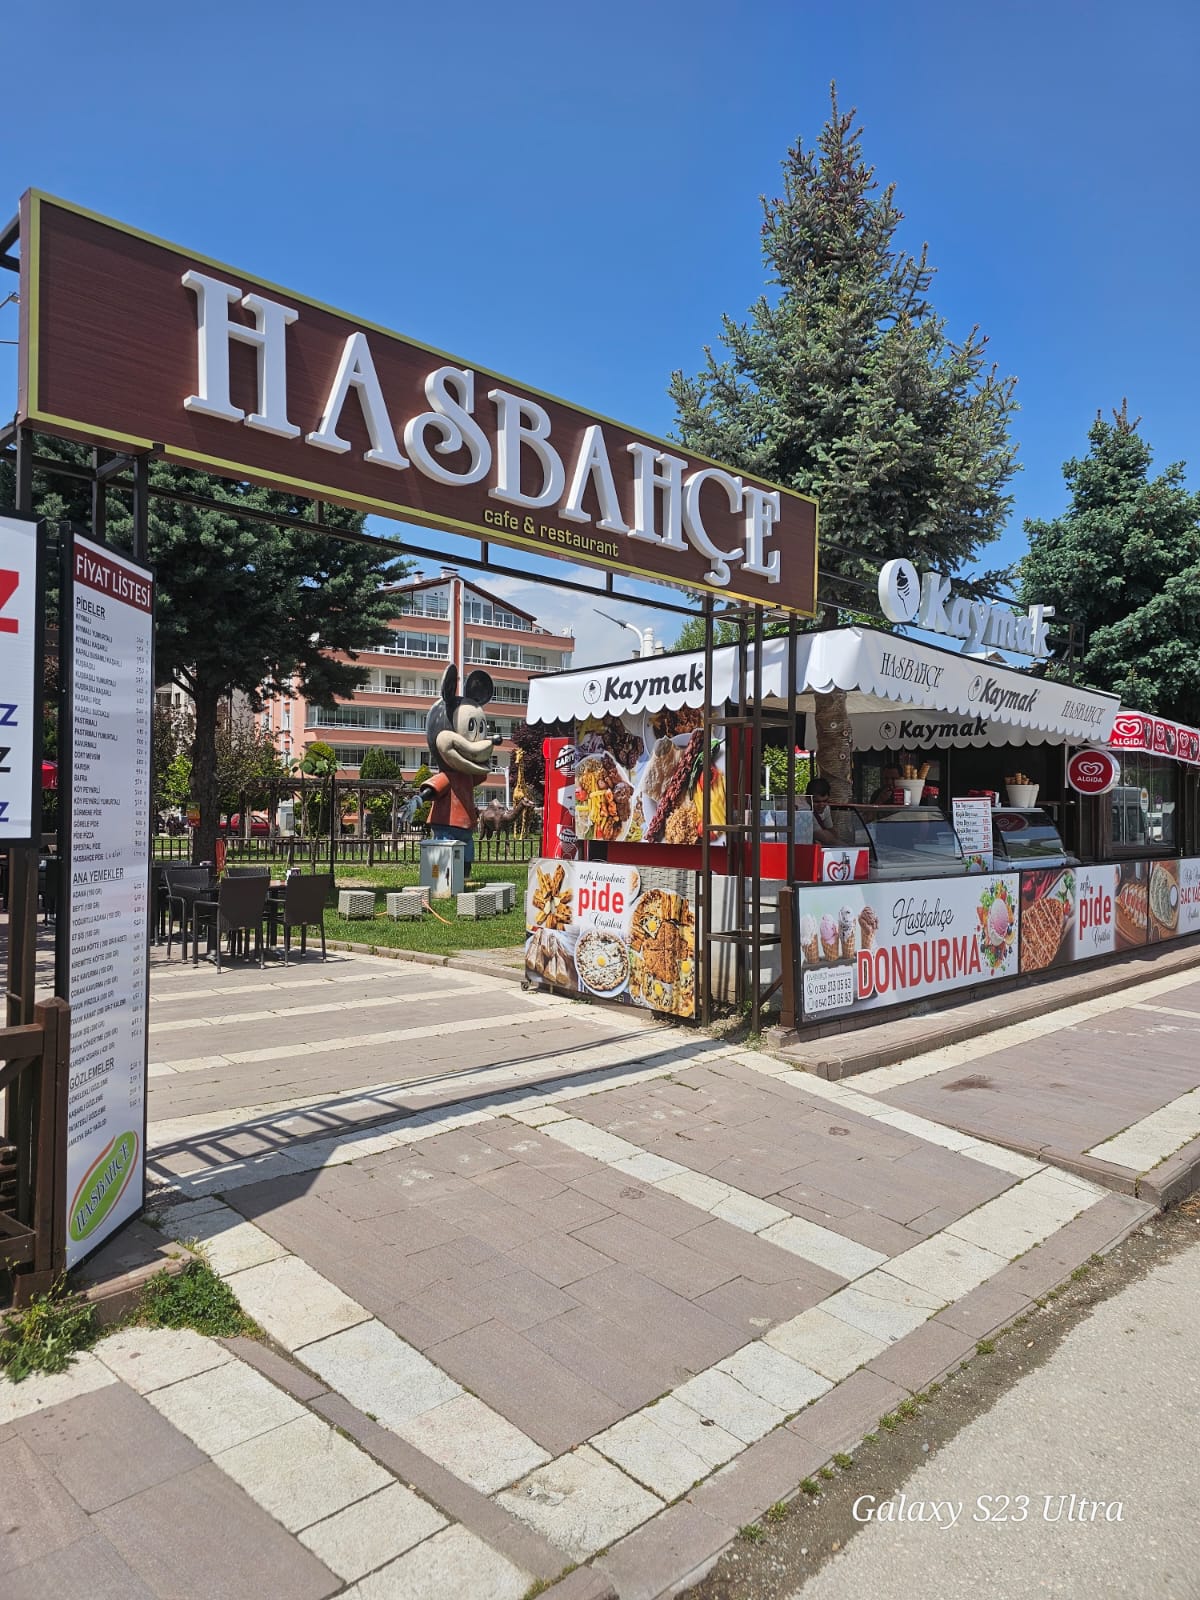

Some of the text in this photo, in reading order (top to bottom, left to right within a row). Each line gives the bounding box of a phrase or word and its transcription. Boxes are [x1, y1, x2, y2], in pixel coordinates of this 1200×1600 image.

[181, 269, 781, 586] HASBAHÇE
[484, 509, 619, 557] cafe & restaurant
[76, 554, 150, 608] FİYAT LİSTESİ
[76, 596, 105, 618] PİDELER
[921, 571, 1054, 657] Kaymak
[603, 663, 704, 705] Kaymak
[880, 652, 944, 692] HASBAHÇE
[980, 678, 1039, 713] Kaymak
[899, 718, 988, 742] Kaymak
[72, 867, 123, 883] ANA YEMEKLER
[577, 882, 624, 917] pide
[892, 898, 954, 936] Hasbahçe
[1079, 885, 1112, 941] pide
[857, 935, 982, 998] DONDURMA
[69, 1057, 114, 1089] GÖZLEMELER
